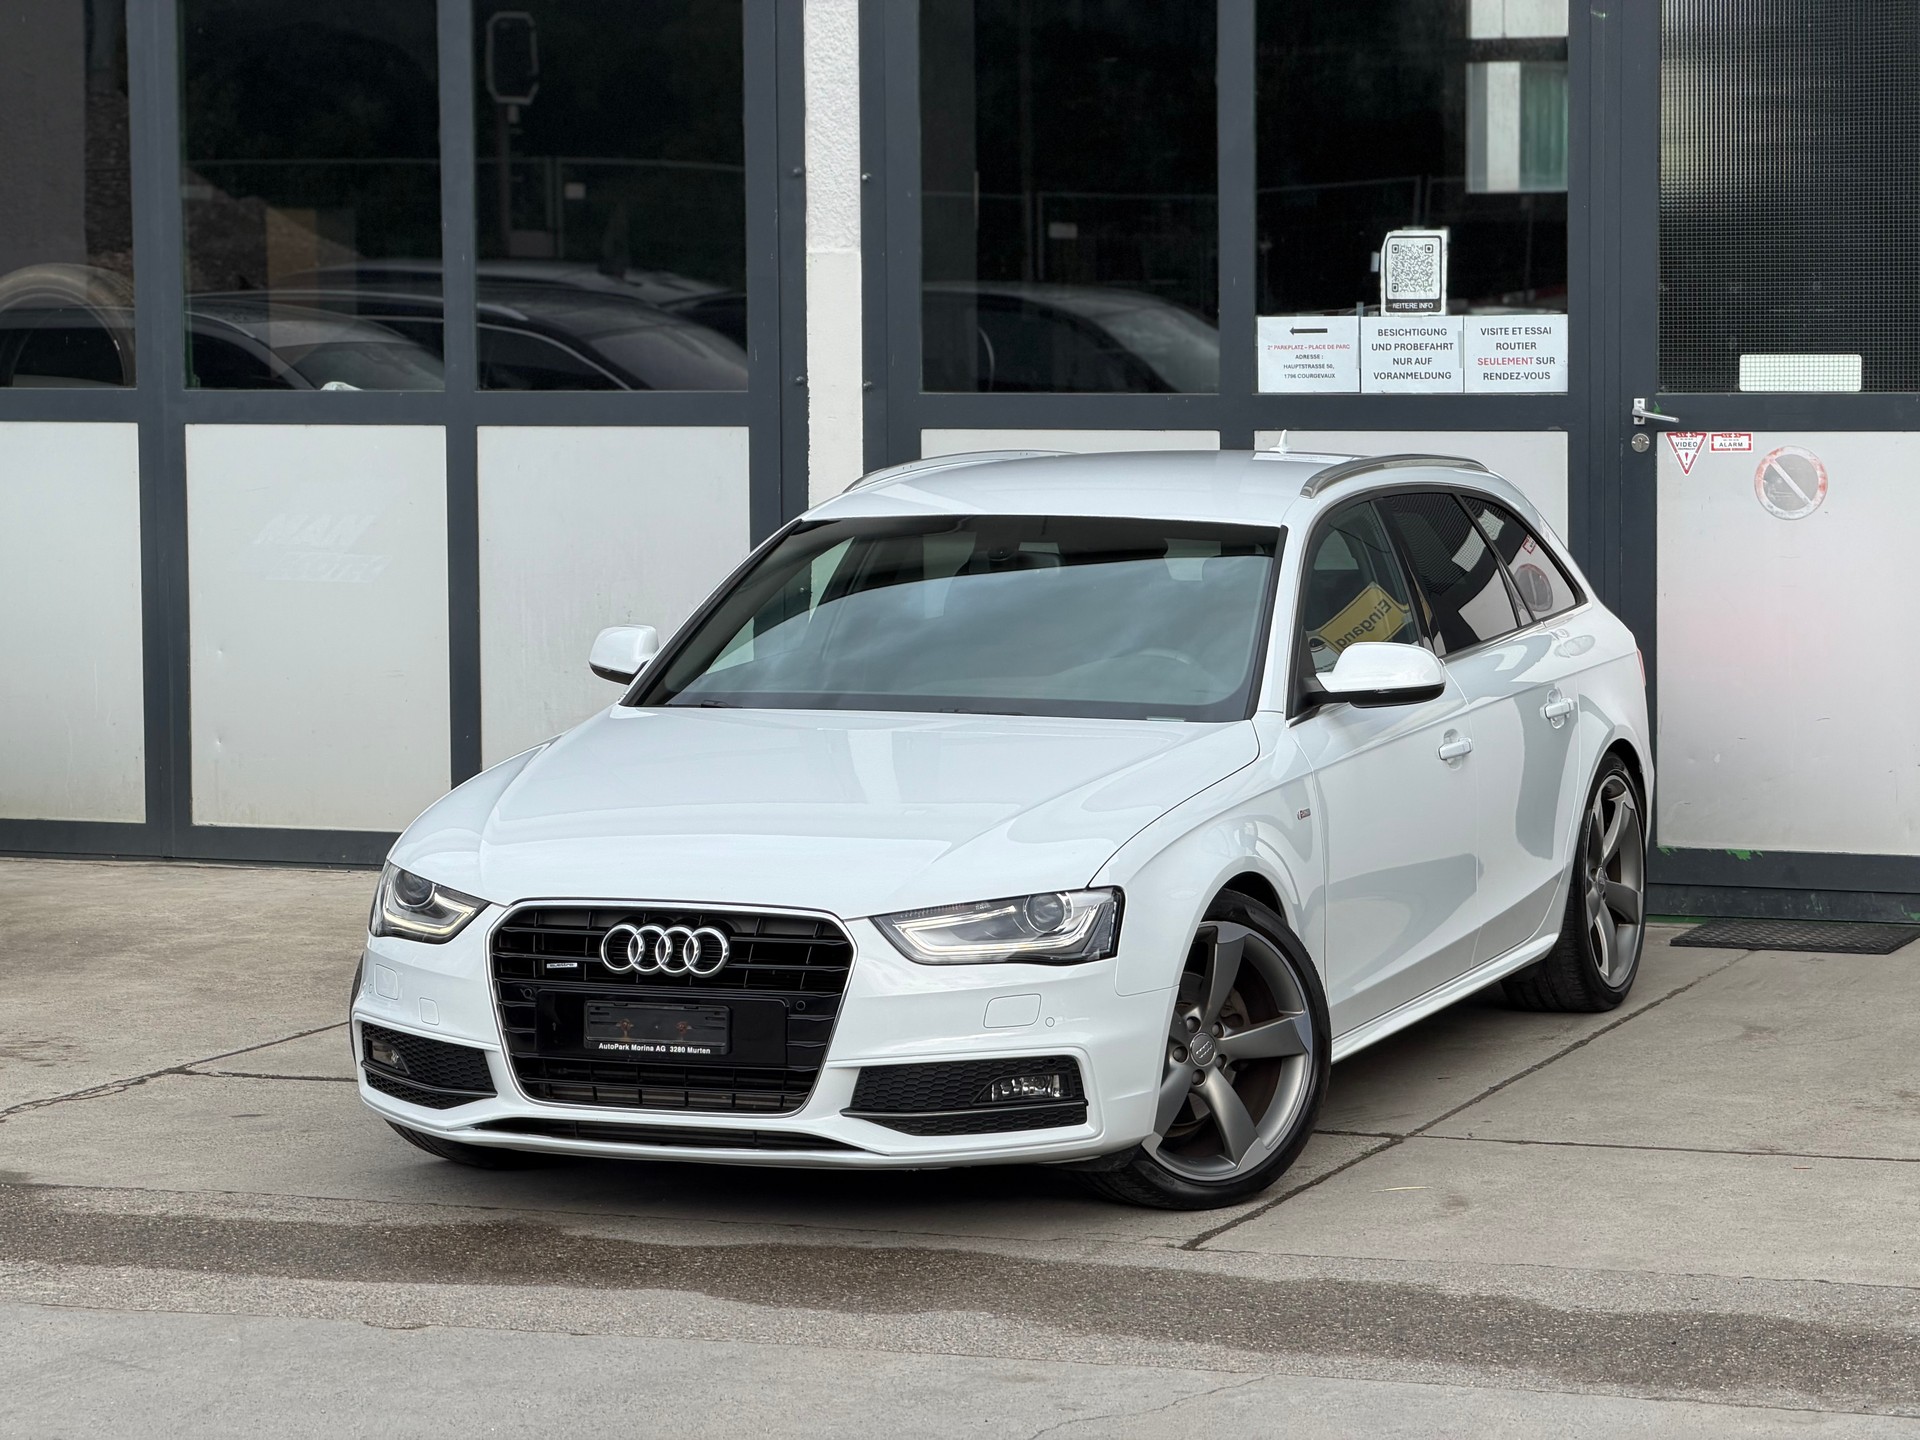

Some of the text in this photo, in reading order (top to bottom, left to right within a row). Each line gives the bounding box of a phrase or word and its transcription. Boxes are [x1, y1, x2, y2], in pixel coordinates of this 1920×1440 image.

[1377, 328, 1447, 337] BESICHTIGUNG
[1480, 326, 1552, 336] VISITE ET ESSAI
[1371, 342, 1454, 351] UND PROBEFAHRT
[1495, 341, 1537, 350] ROUTIER
[1392, 357, 1433, 365] NUR AUF
[1477, 356, 1556, 366] SEULEMENT SUR
[1373, 371, 1452, 380] VORANMELDUNG
[1482, 371, 1551, 380] RENDEZ-VOUS
[598, 1042, 711, 1054] AutoPark Morina AG 3280 Murten
